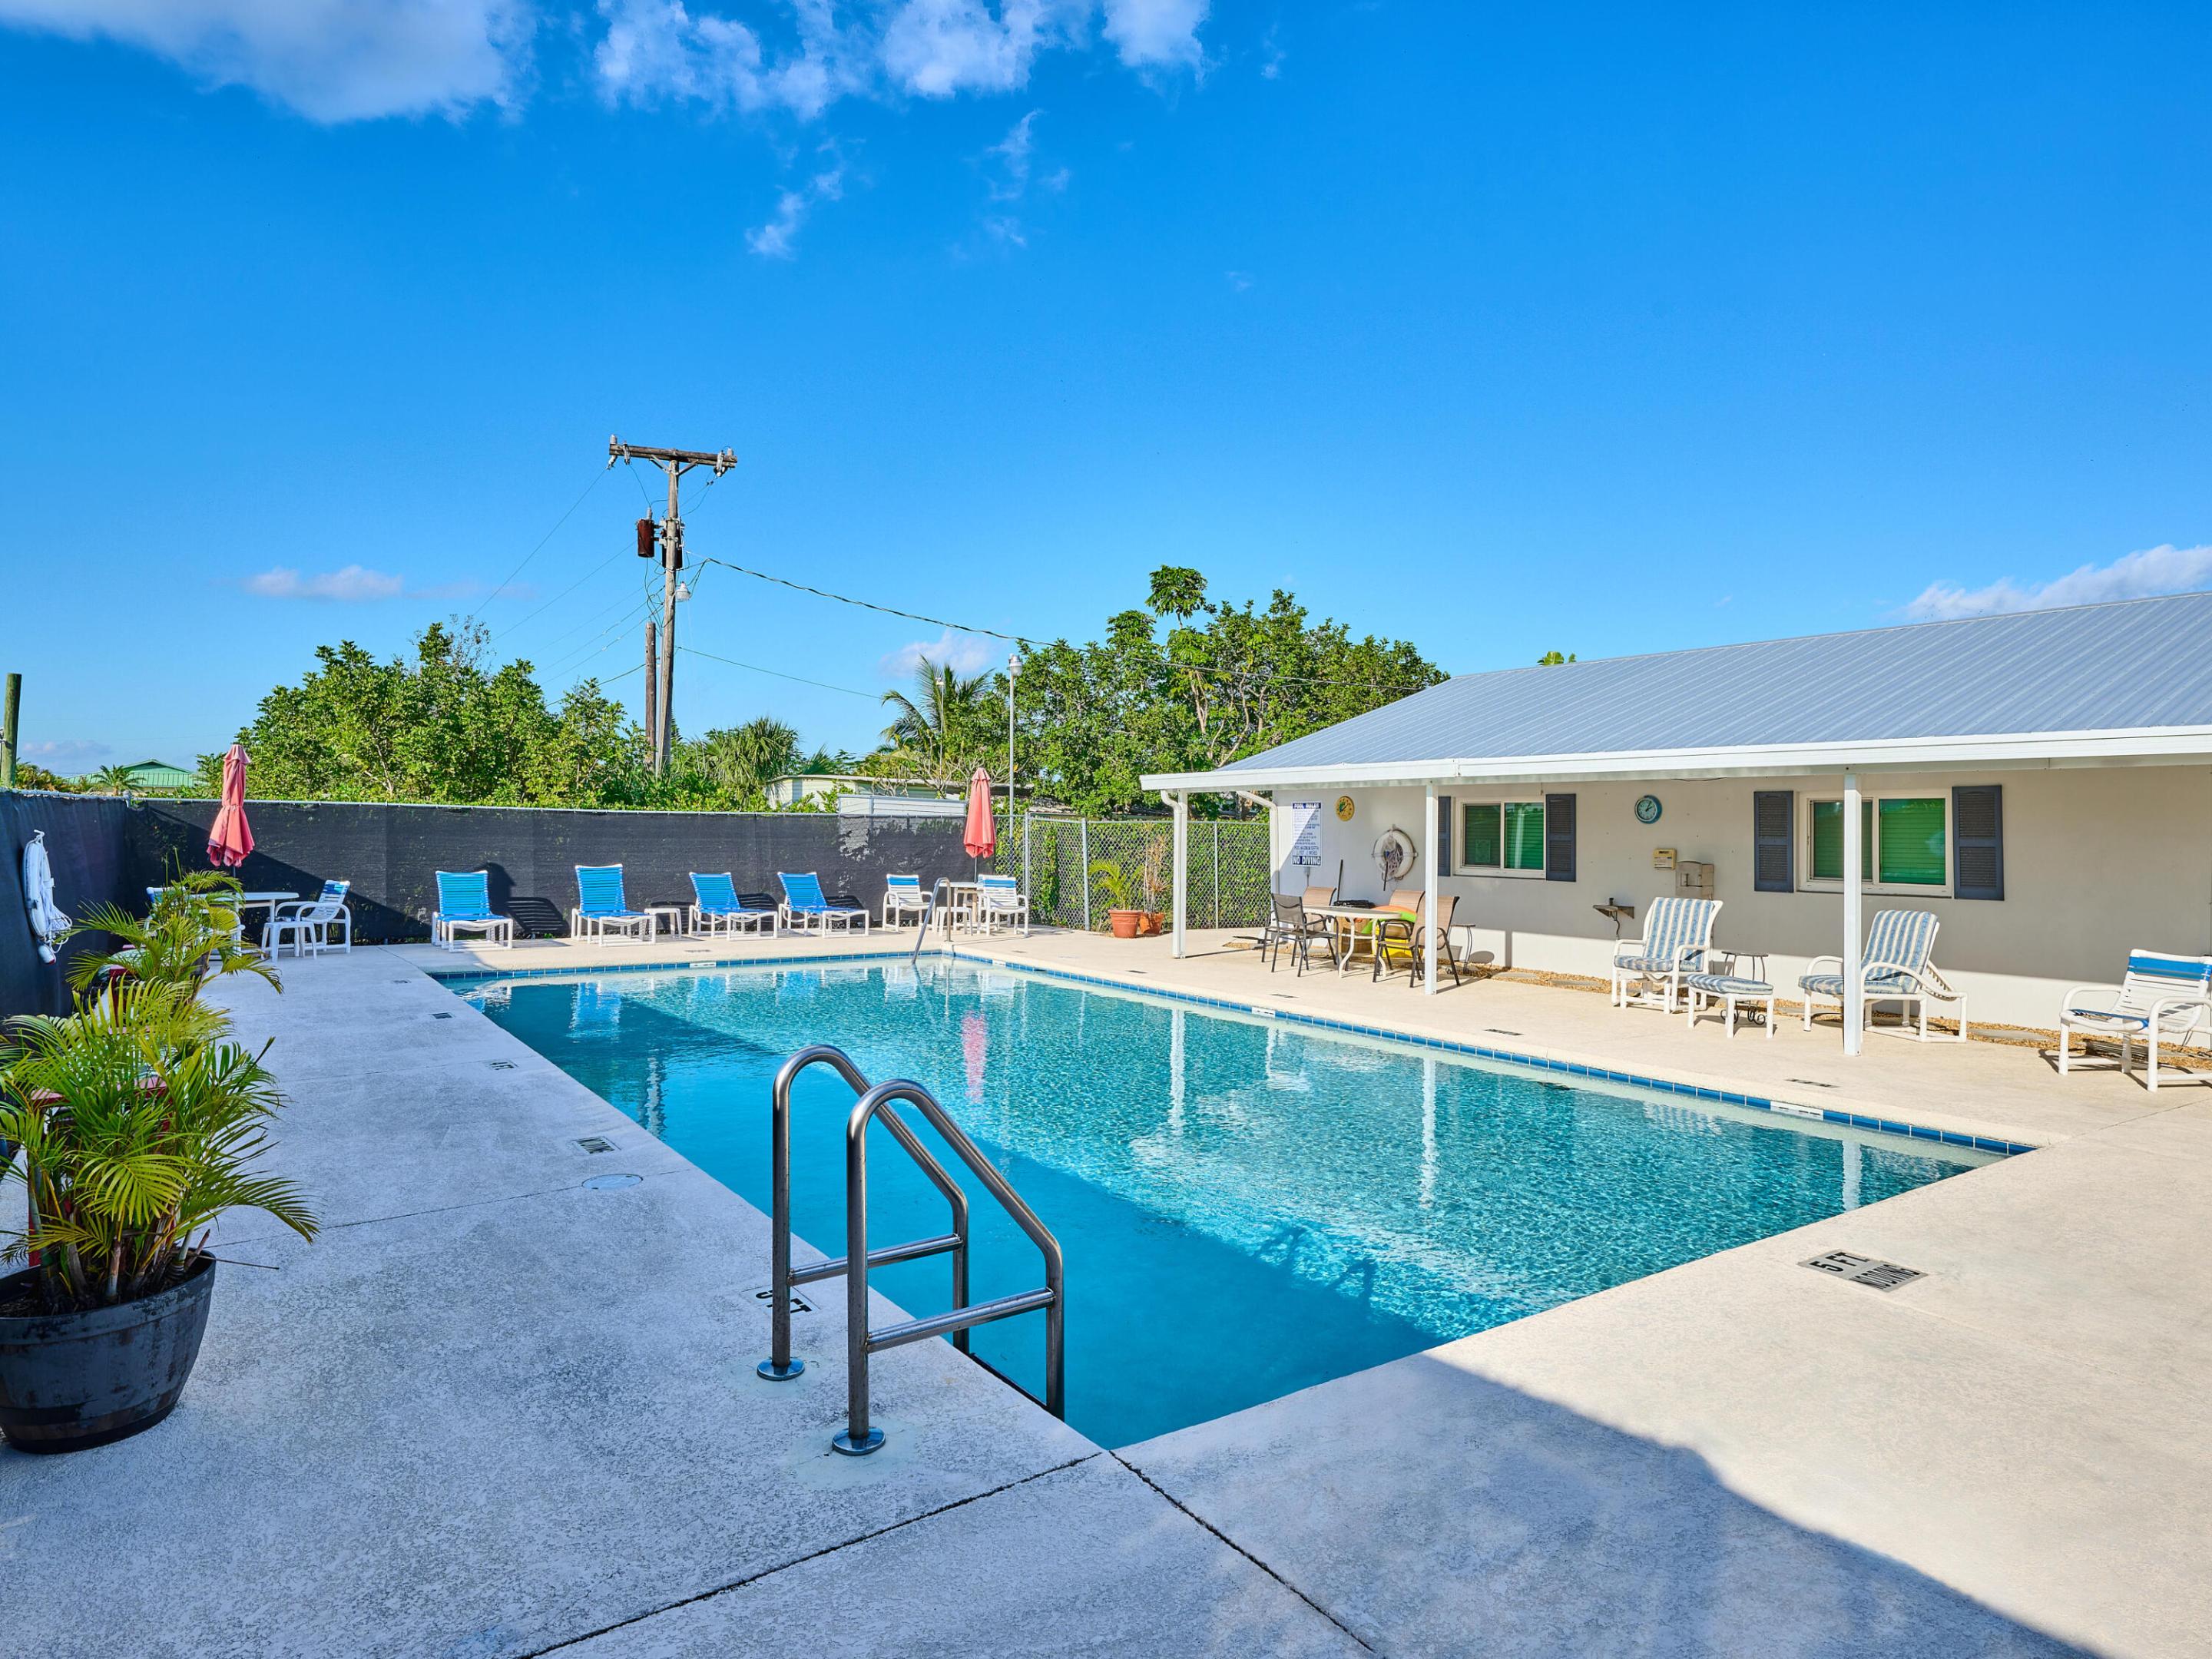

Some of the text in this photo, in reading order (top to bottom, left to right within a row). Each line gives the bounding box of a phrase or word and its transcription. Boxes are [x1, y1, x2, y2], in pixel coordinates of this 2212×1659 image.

[1293, 856, 1320, 865] NO DIVING
[1809, 1252, 1869, 1272] 5 FT
